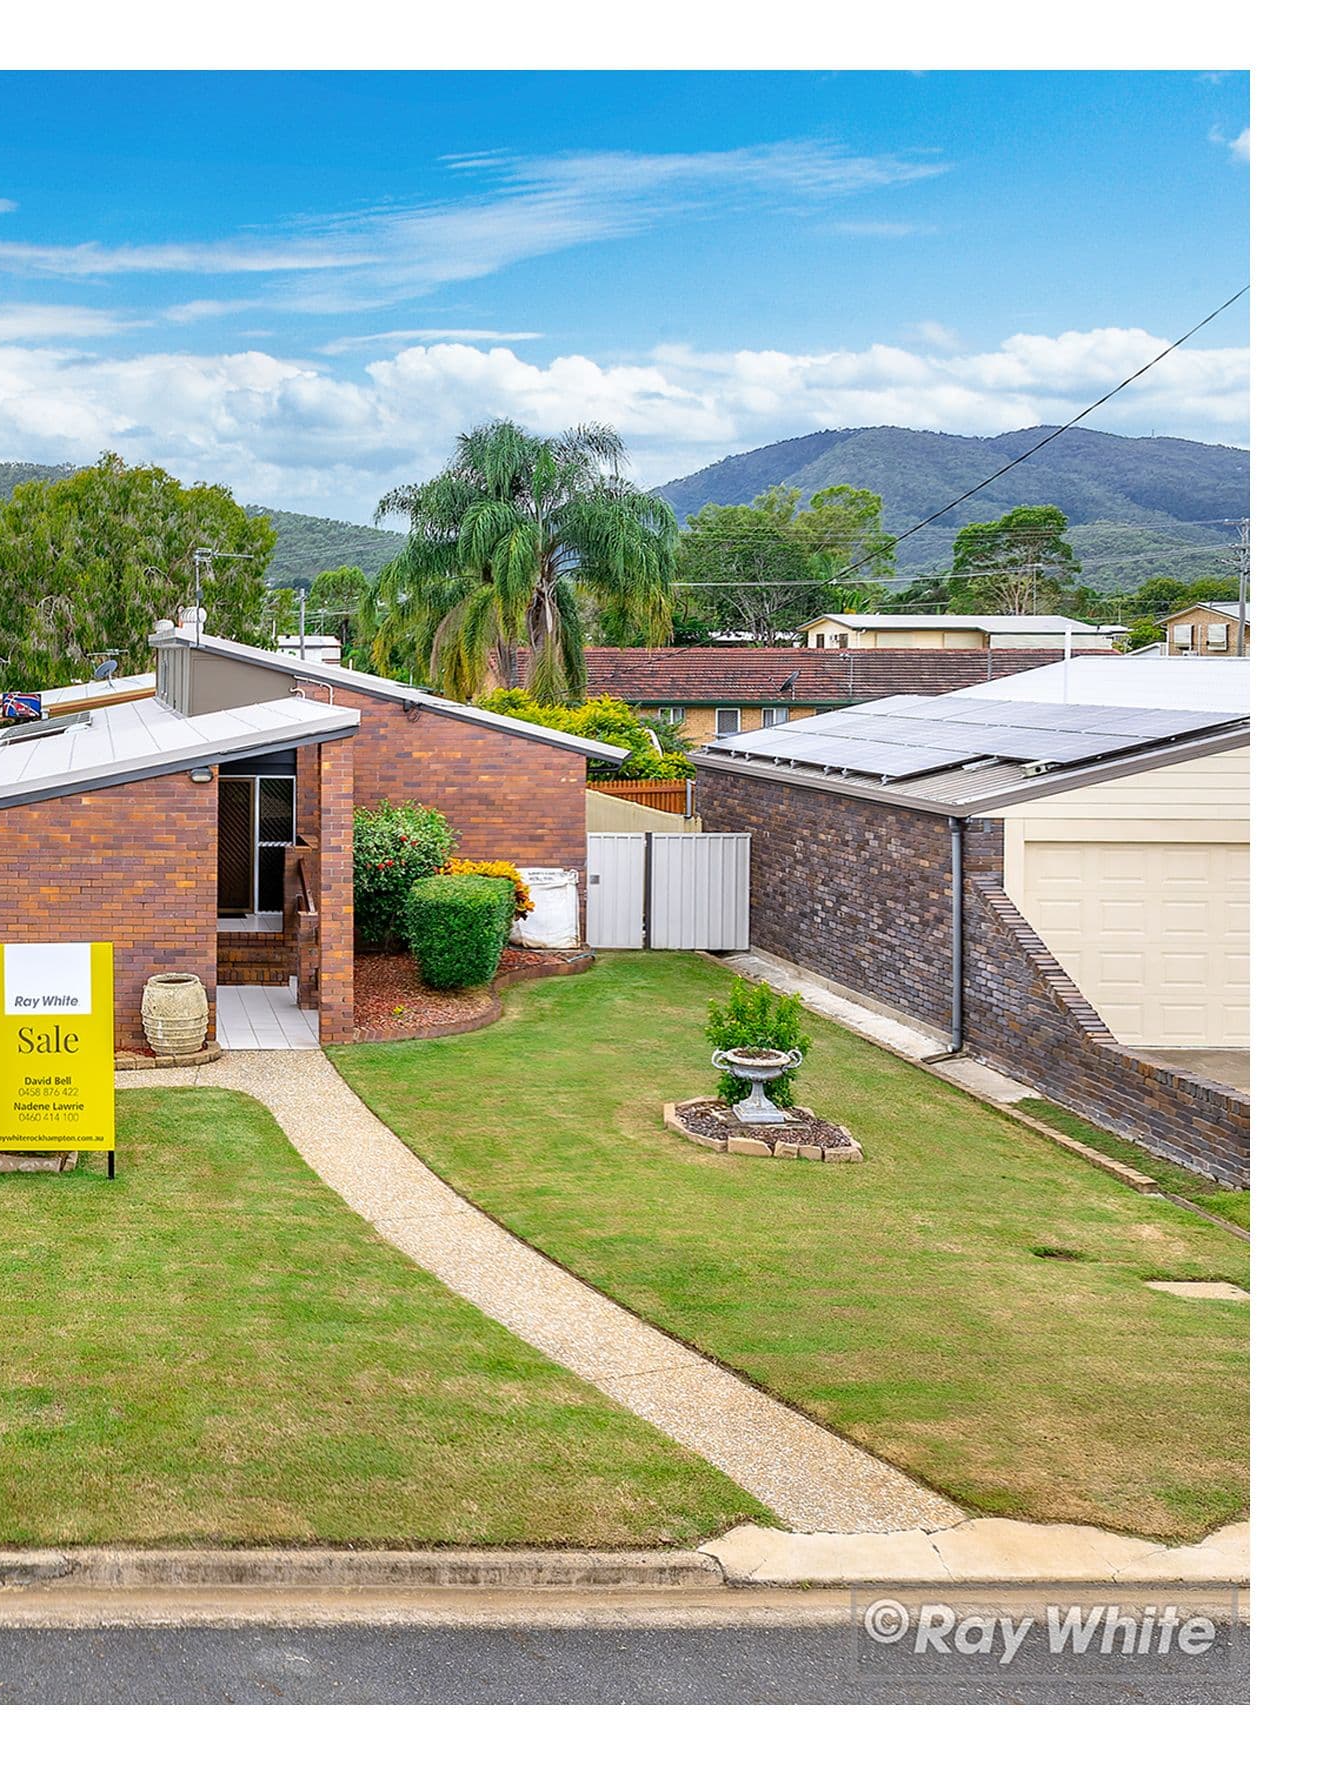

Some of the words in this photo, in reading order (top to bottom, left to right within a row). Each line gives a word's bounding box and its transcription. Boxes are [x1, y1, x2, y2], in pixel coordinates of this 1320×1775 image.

[14, 995, 40, 1009] Ray
[42, 995, 79, 1007] White
[18, 1025, 79, 1054] Sale
[24, 1076, 52, 1086] David
[54, 1076, 72, 1086] Bell
[18, 1087, 41, 1097] 0458
[43, 1087, 60, 1097] 876
[62, 1087, 79, 1097] 422
[13, 1102, 50, 1111] Nadene
[52, 1101, 84, 1111] Lawrie
[43, 1112, 60, 1122] 414
[64, 1112, 79, 1122] 100
